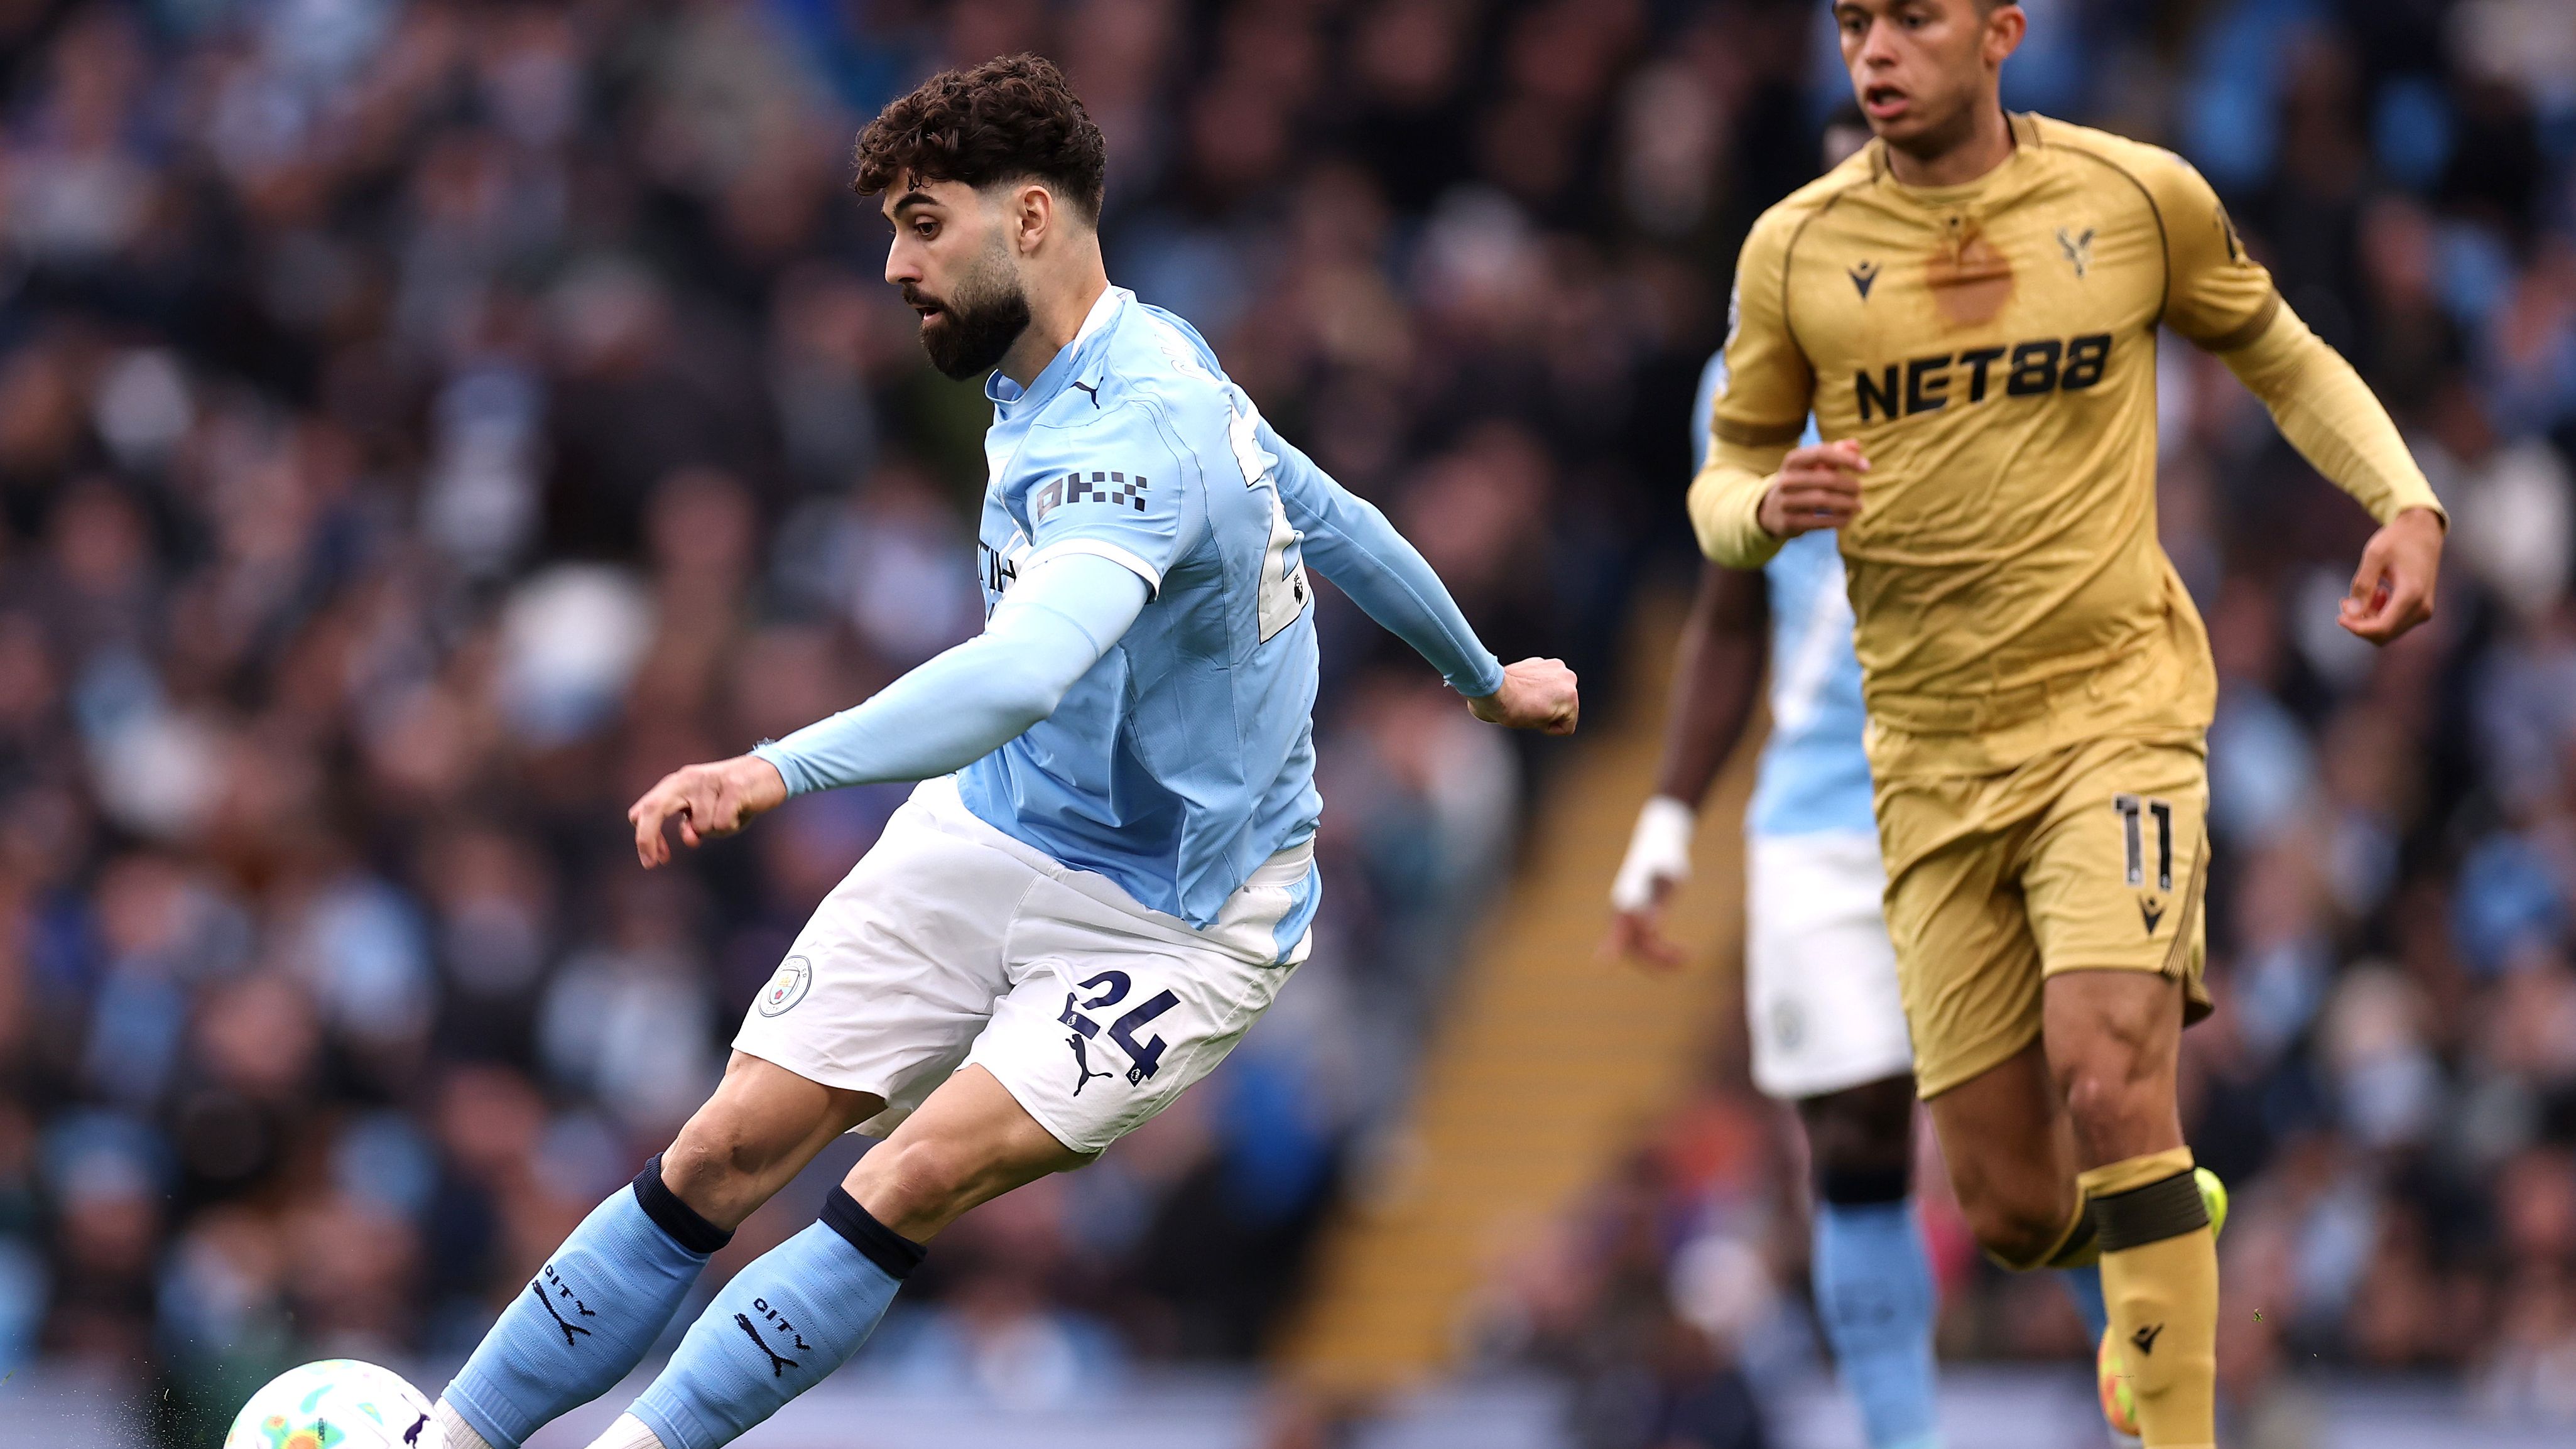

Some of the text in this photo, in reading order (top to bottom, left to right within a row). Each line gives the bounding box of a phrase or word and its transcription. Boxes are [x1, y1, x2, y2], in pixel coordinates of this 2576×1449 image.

[1855, 334, 2112, 422] NET88
[1036, 472, 1148, 521] OKX
[2113, 794, 2172, 892] 11
[1057, 970, 1180, 1087] 24
[545, 1264, 595, 1317] CITY
[754, 1298, 810, 1350] CITY
